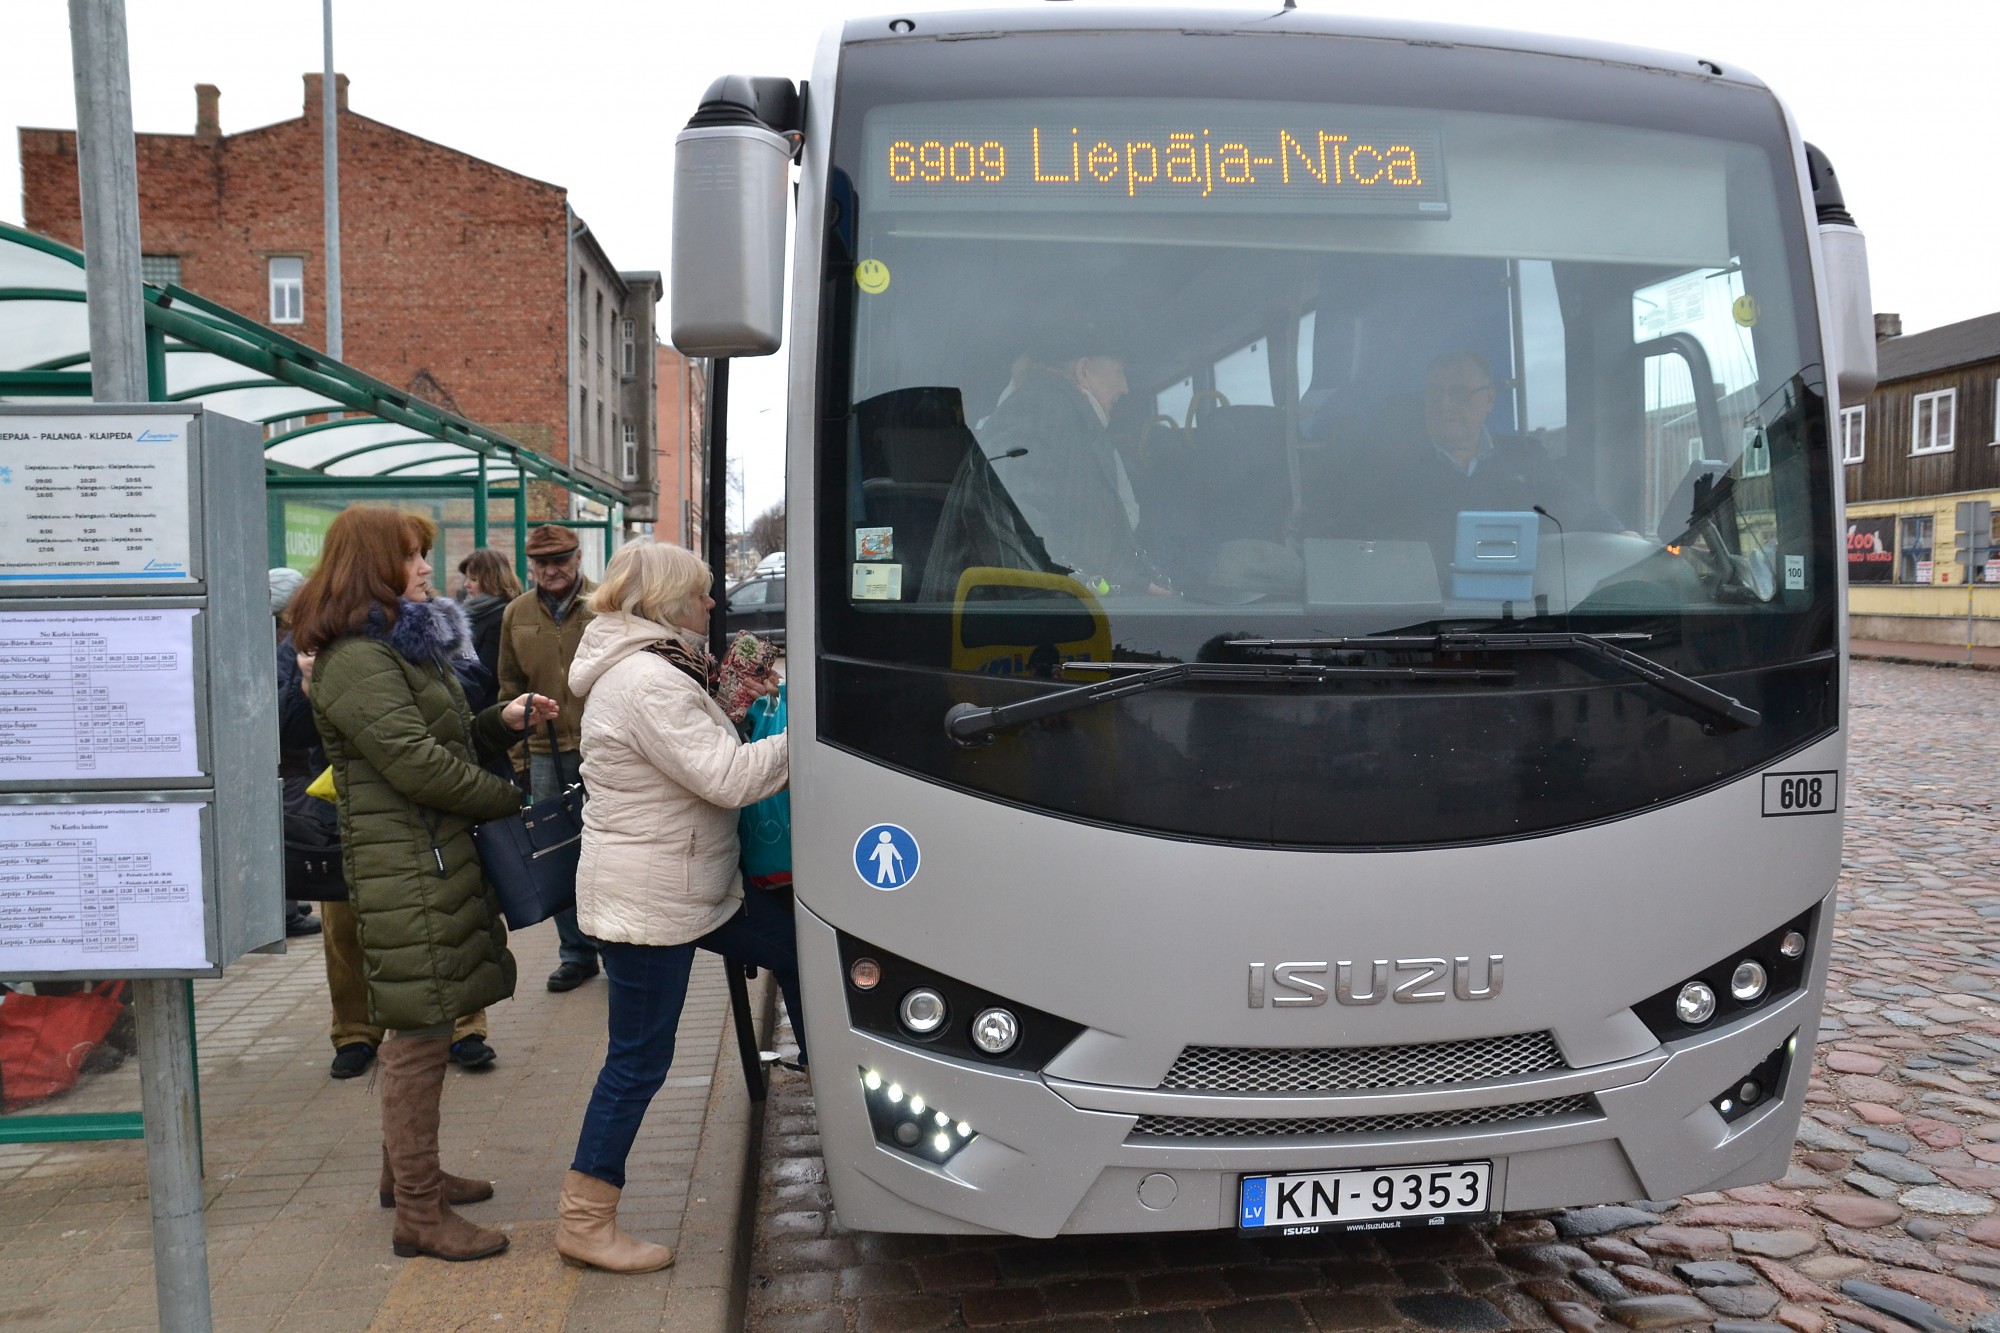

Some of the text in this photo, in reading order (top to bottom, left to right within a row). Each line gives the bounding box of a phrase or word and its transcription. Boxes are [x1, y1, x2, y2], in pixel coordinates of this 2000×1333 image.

[890, 127, 1423, 197] 6909 Liepāja-Nīca
[90, 432, 133, 440] KLAIPEDA
[1847, 532, 1874, 549] ZOO
[1788, 568, 1802, 578] 100
[1780, 777, 1822, 810] 608
[1248, 955, 1504, 1009] ISUZU
[1277, 1170, 1480, 1220] KN-9353
[1245, 1206, 1263, 1219] LV
[1283, 1226, 1319, 1236] ISUZU
